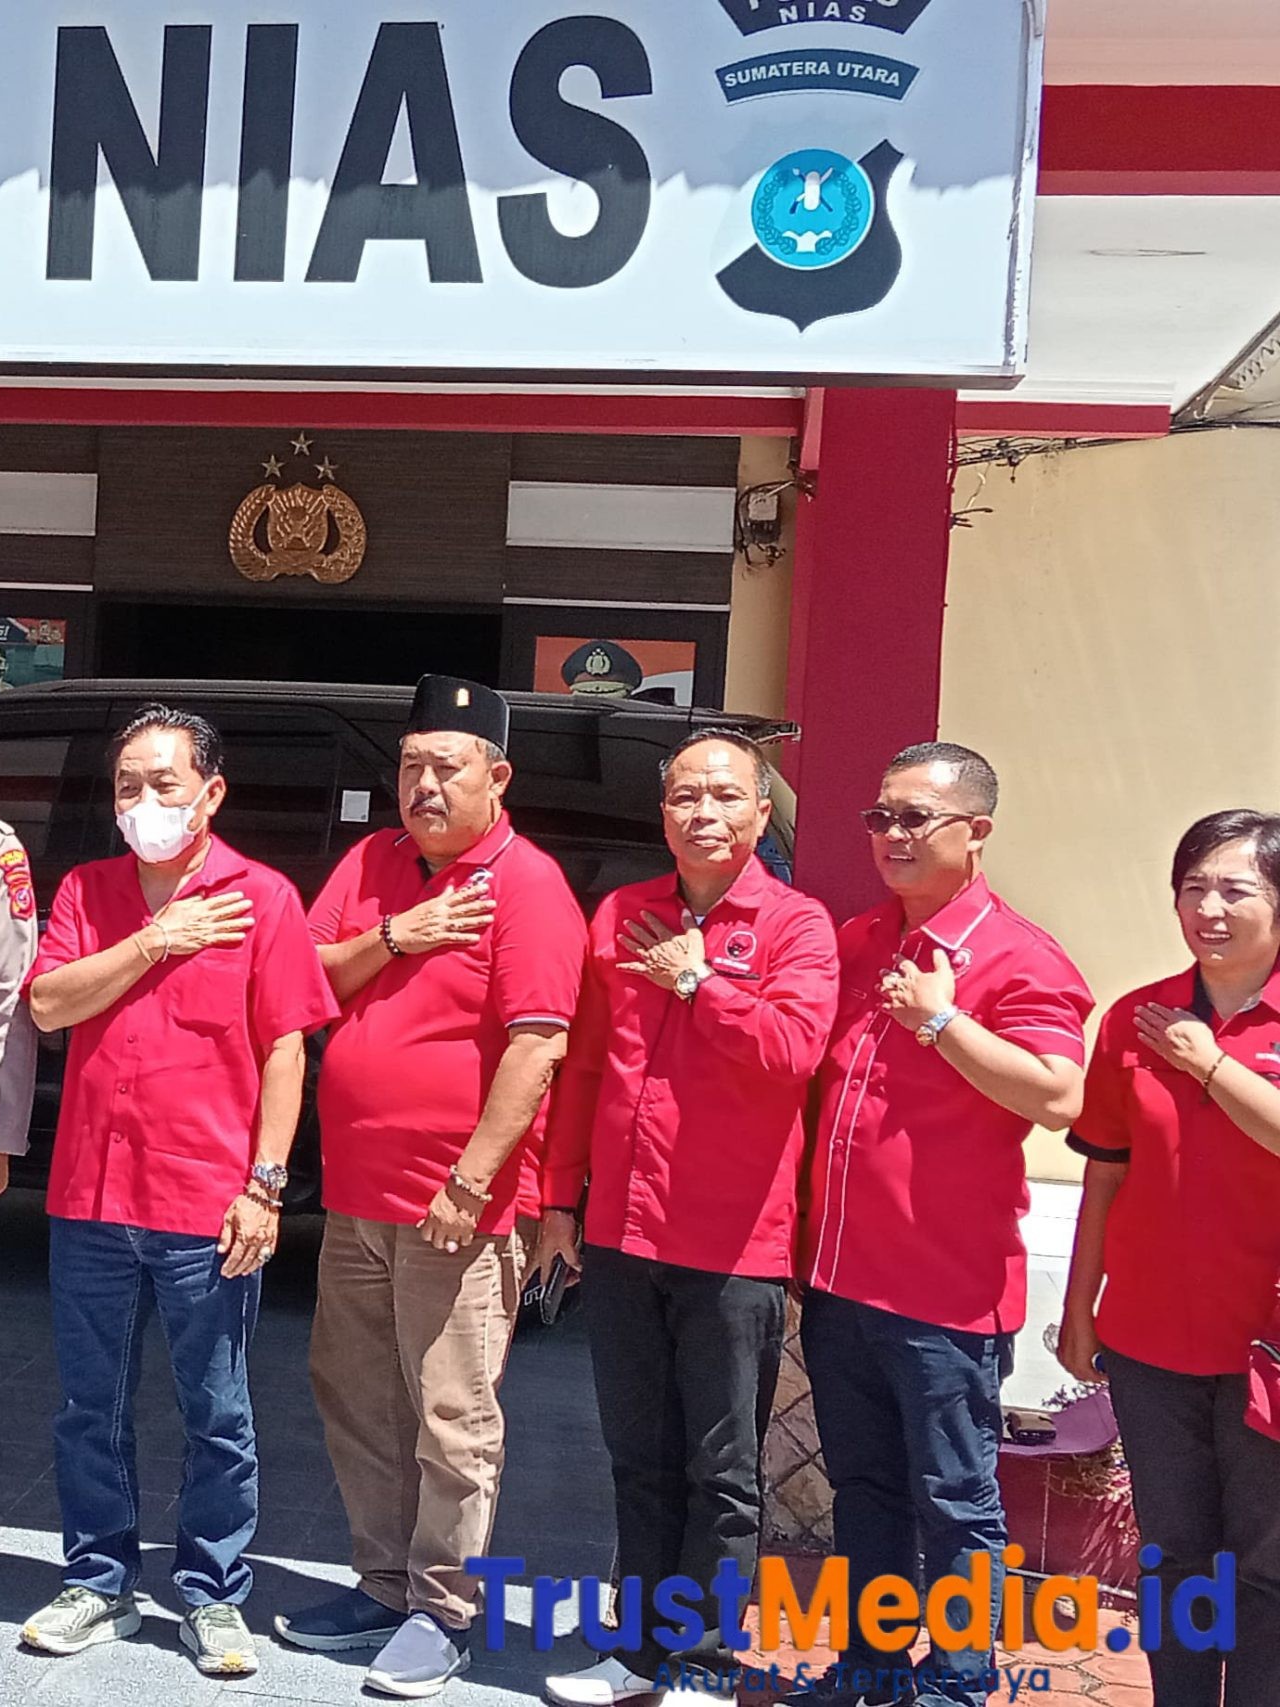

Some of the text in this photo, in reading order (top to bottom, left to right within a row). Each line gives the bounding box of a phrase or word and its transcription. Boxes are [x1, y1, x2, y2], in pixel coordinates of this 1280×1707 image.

[779, 2, 867, 24] NIAS
[724, 61, 900, 87] SUMATERA UTARA
[45, 15, 653, 289] NIAS
